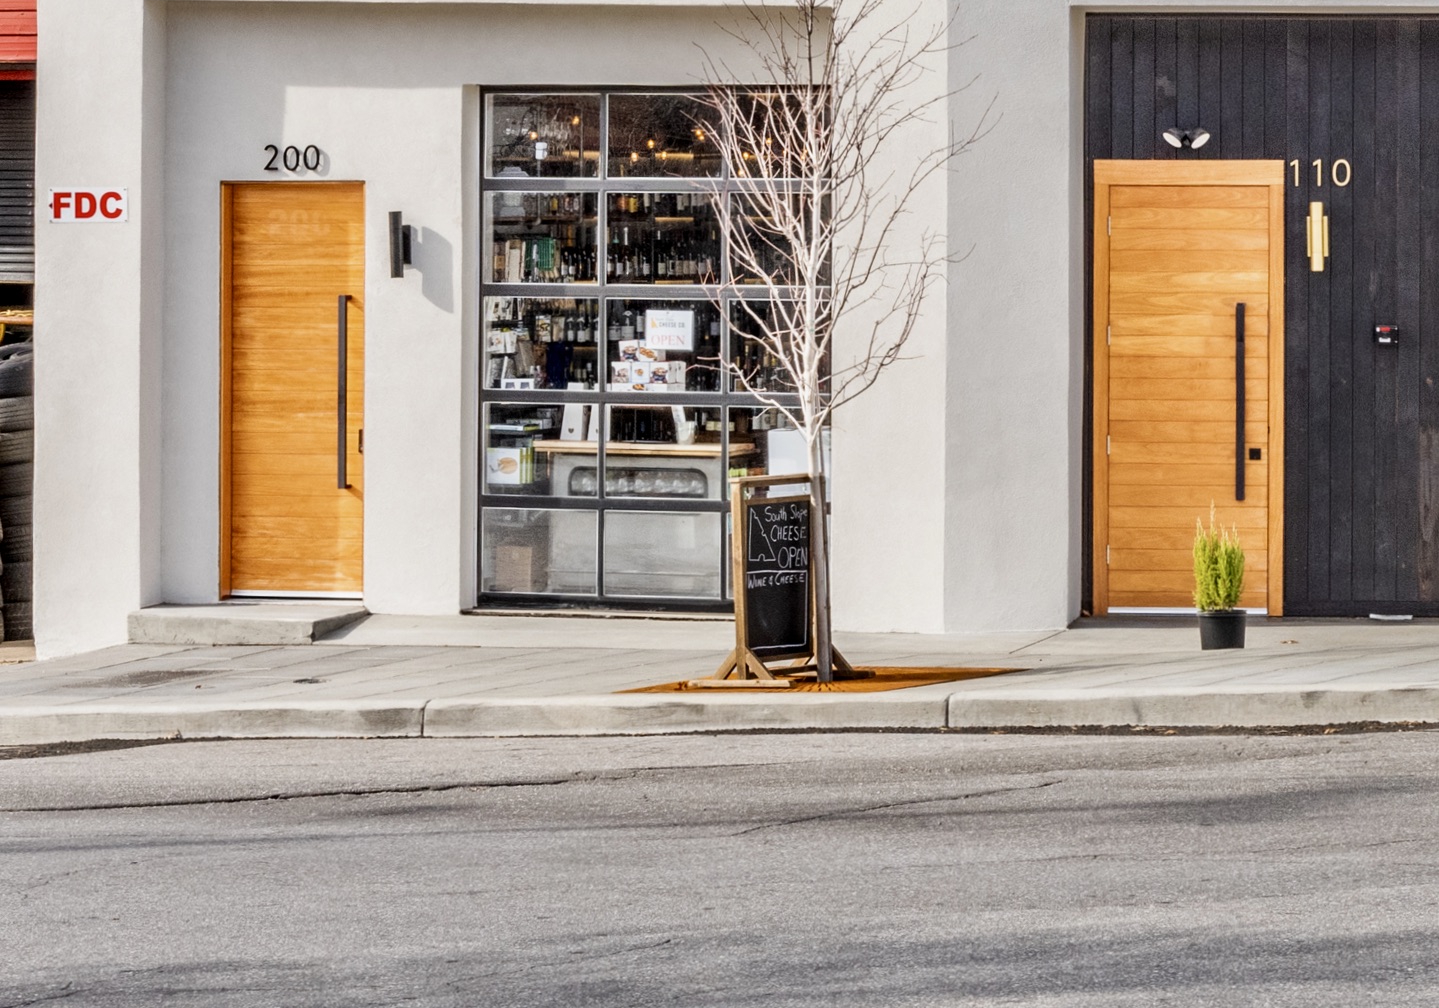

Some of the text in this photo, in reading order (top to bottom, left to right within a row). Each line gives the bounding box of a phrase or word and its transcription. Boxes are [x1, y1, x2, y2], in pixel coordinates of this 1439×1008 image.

[263, 144, 320, 171] 200
[1289, 158, 1351, 187] 110
[53, 191, 123, 219] FDC
[651, 335, 685, 345] OPEN
[764, 506, 787, 522] South
[770, 524, 807, 542] CHEESE
[777, 546, 808, 569] OPEN
